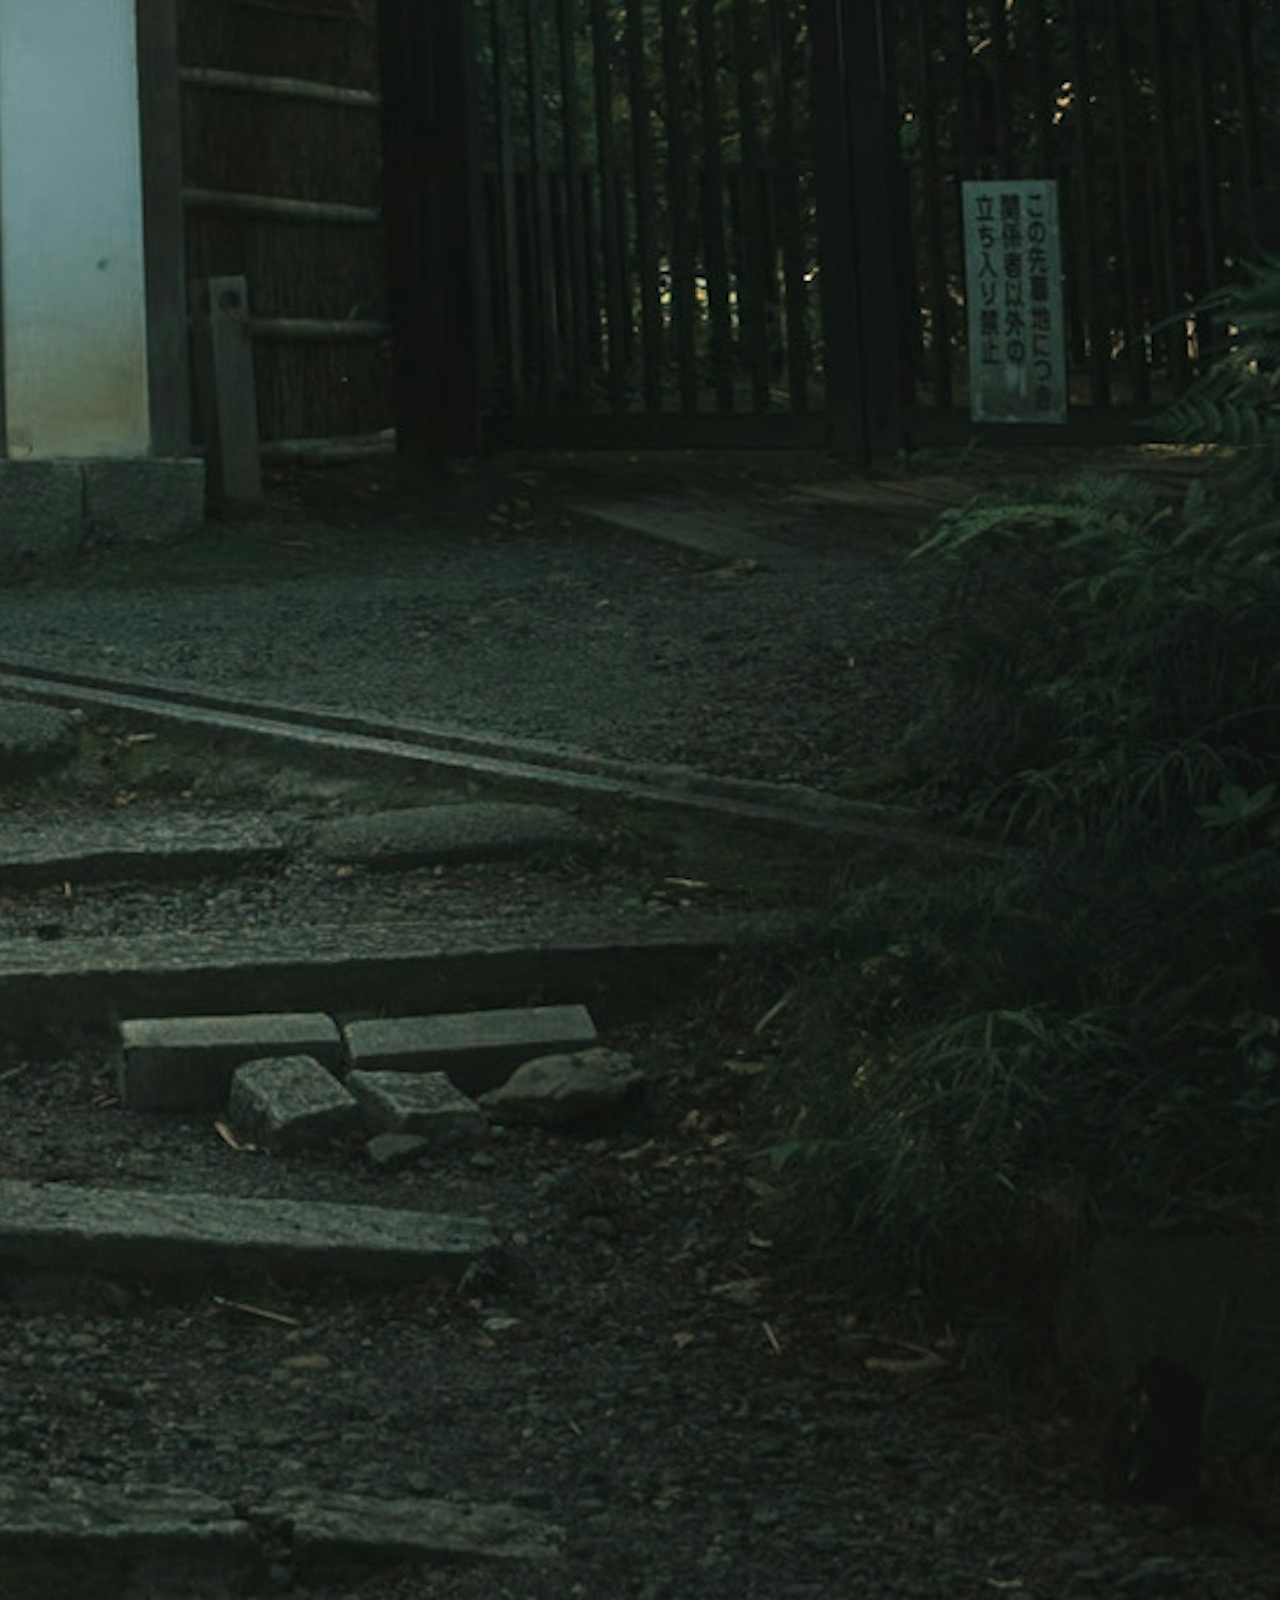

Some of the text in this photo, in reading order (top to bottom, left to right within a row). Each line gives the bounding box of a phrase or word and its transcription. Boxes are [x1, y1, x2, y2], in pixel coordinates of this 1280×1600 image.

[975, 193, 1000, 366] 立ち入り禁止
[1001, 193, 1026, 364] 関係者以外の
